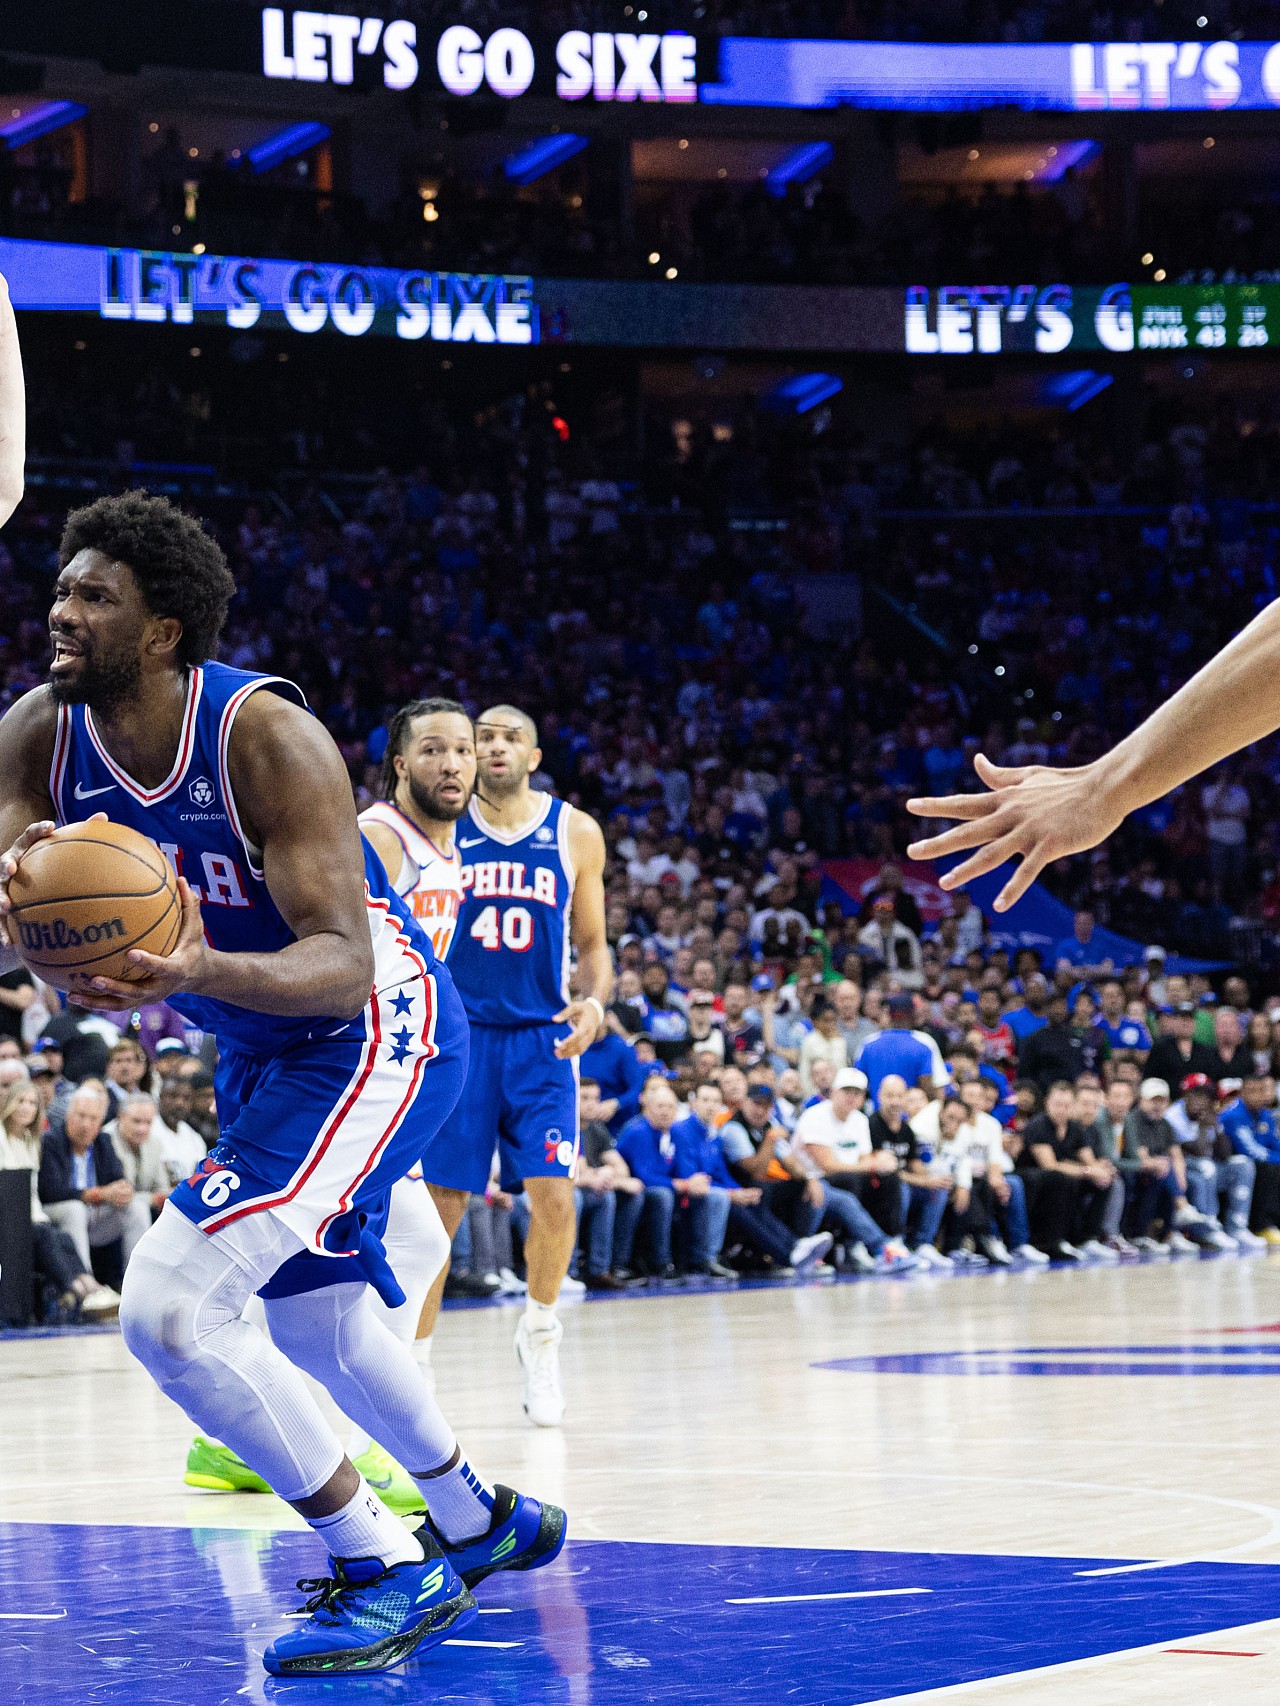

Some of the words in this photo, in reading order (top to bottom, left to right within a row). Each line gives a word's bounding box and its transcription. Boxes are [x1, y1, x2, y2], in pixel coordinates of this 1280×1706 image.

[262, 8, 418, 89] LET'S
[437, 25, 535, 98] GO
[556, 30, 696, 102] SIXE
[1073, 41, 1242, 110] LET'S
[100, 247, 261, 329] LET'S
[284, 265, 376, 336] GO
[396, 271, 533, 343] SIXE
[905, 284, 1073, 353] LET'S
[16, 917, 128, 951] Wilson
[471, 905, 534, 952] 40
